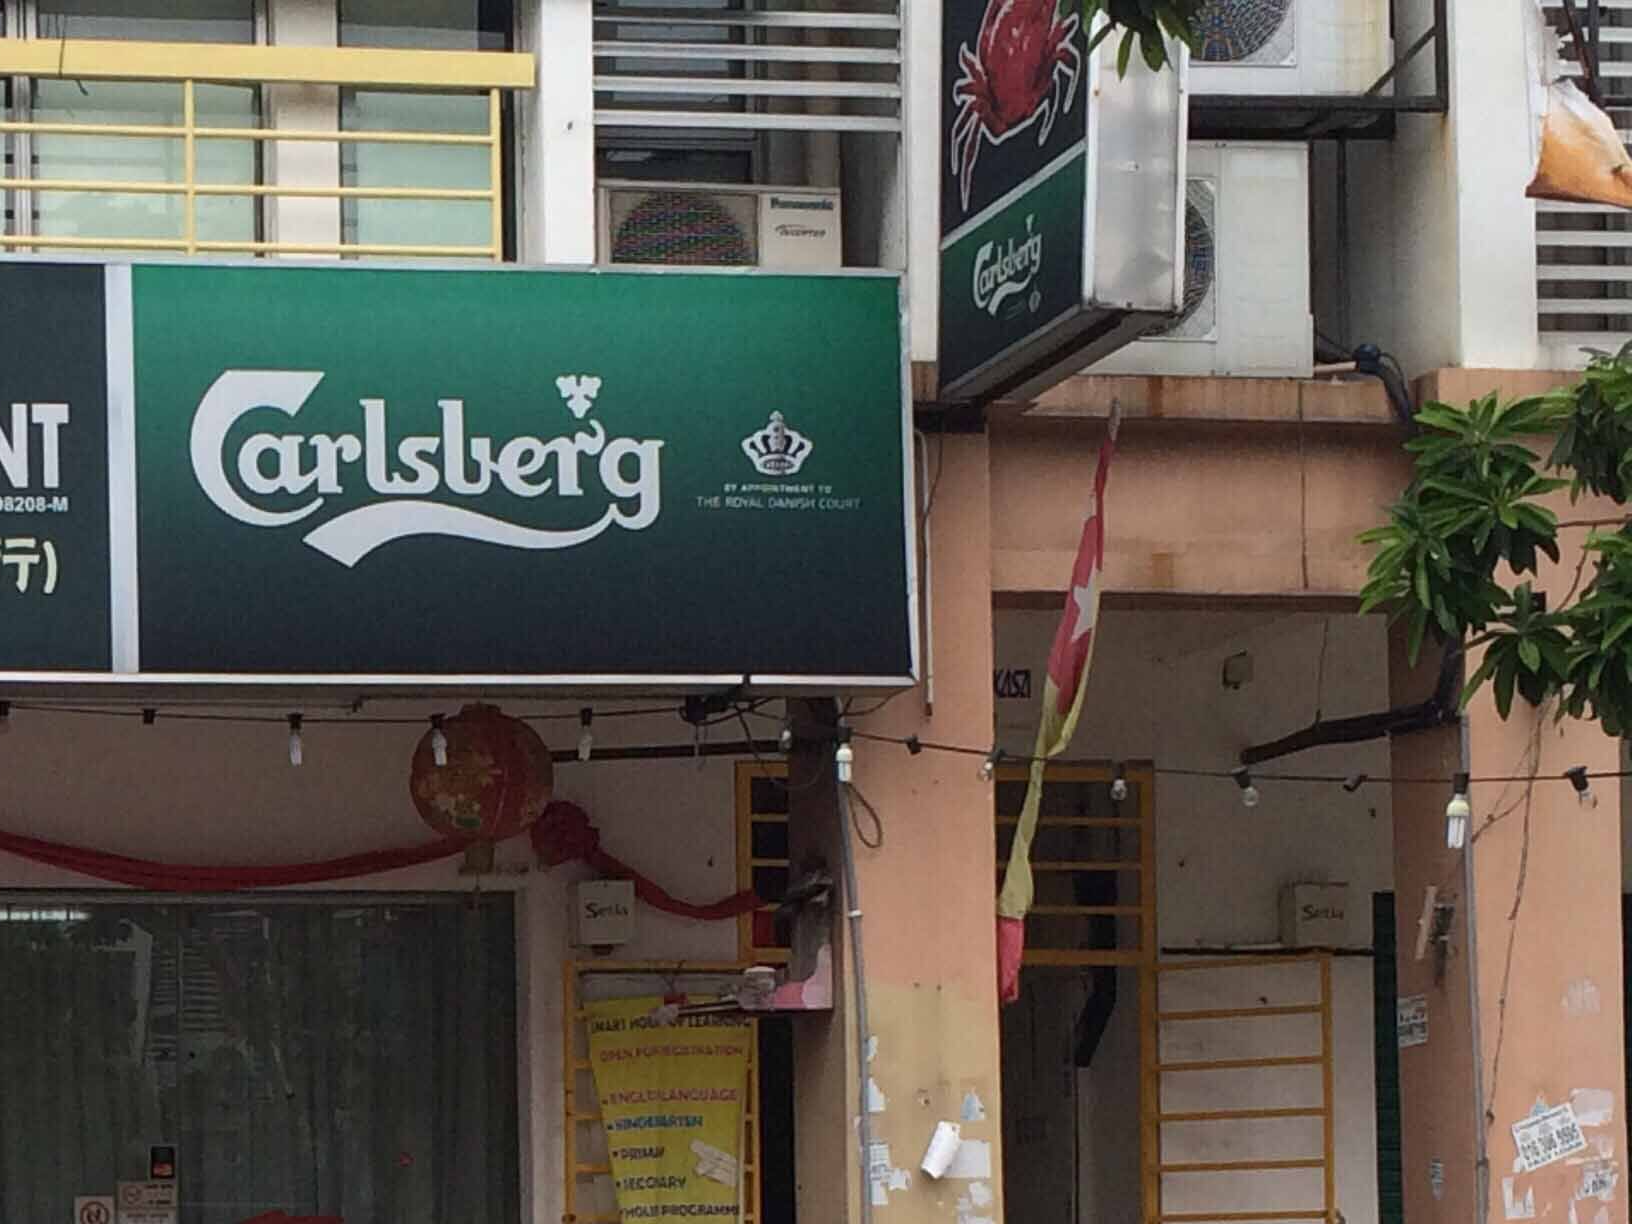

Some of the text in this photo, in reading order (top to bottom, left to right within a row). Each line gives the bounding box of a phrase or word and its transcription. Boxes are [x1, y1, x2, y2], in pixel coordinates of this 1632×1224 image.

[973, 213, 1042, 316] Carlsberg
[189, 369, 665, 567] Carlsberg
[696, 496, 860, 511] THE ROYAL DANISH COURT
